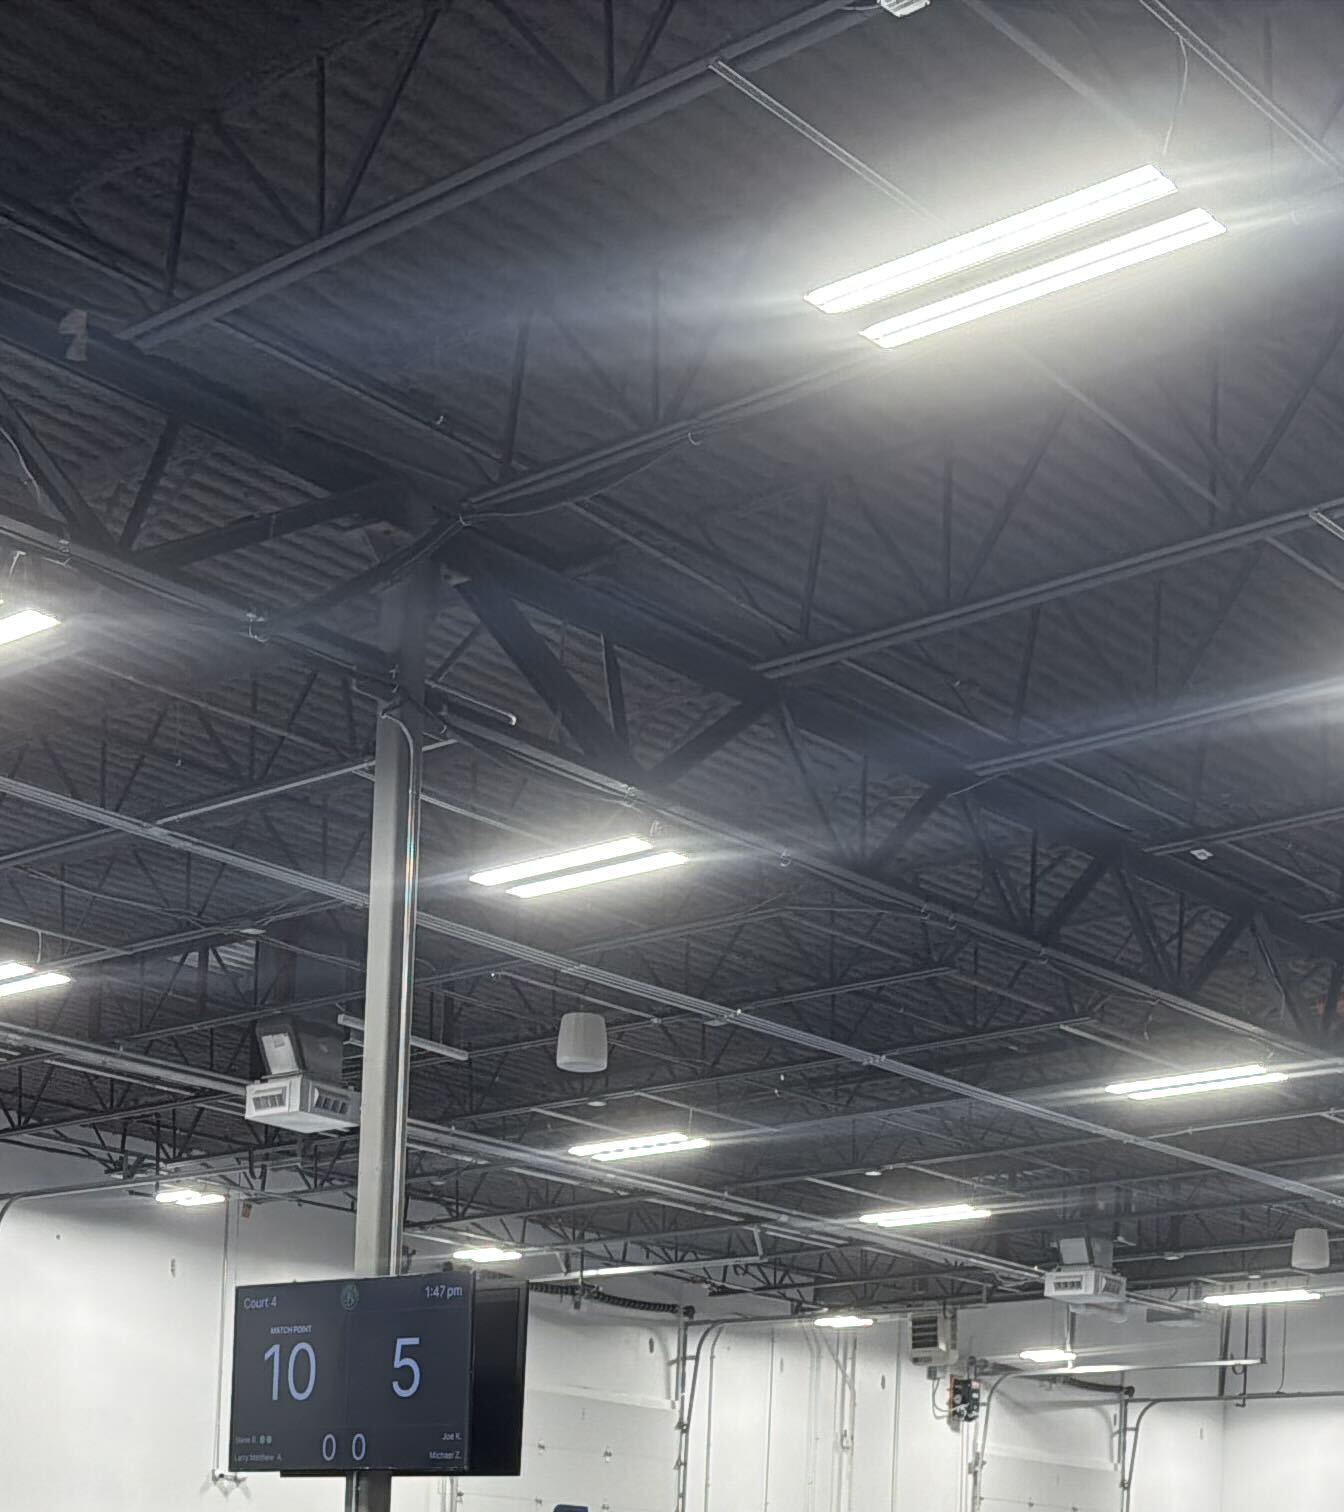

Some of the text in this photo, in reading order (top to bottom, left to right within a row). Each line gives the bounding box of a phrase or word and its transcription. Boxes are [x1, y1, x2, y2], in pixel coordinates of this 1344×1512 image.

[244, 1296, 277, 1309] Court 4
[425, 1285, 463, 1299] 1:47 pm
[270, 1325, 312, 1335] MATCH POINT
[263, 1341, 317, 1401] 10
[392, 1337, 421, 1398] 5
[322, 1433, 336, 1461] 0
[352, 1433, 366, 1461] 0
